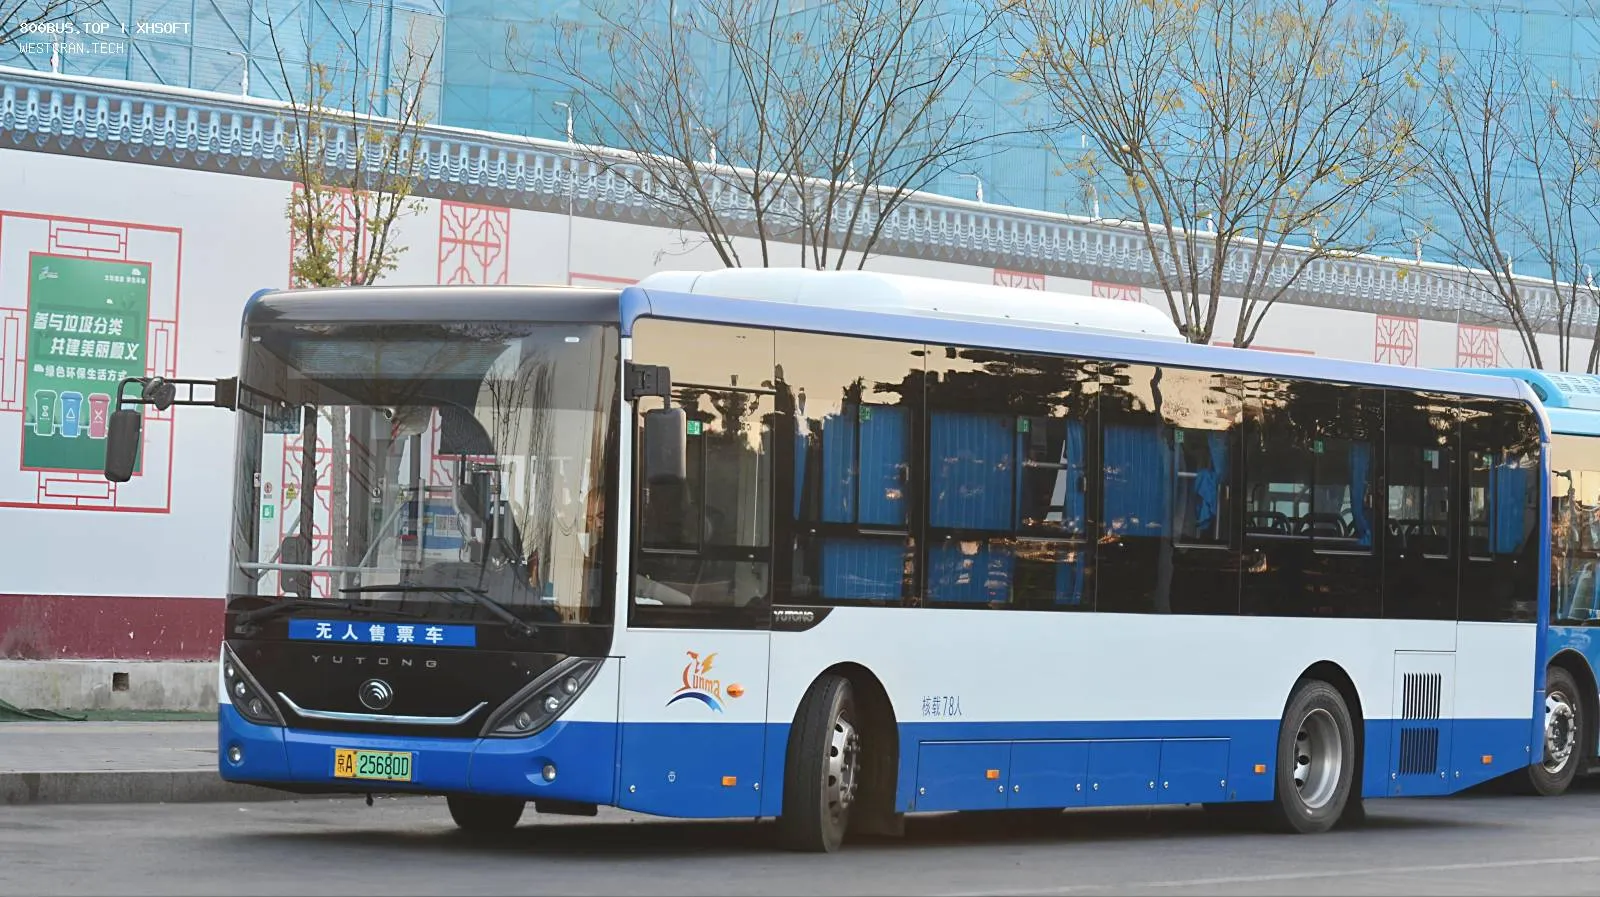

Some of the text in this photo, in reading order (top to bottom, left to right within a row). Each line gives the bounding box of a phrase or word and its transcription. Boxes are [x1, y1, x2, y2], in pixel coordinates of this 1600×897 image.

[33, 311, 124, 336] 参与垃圾分类
[50, 336, 140, 361] 共建美丽顺义
[44, 363, 128, 382] 绿色环保生活方式
[774, 609, 815, 623] YUTONG
[315, 621, 444, 644] 无人售票车
[311, 654, 438, 669] YUTONG
[921, 695, 963, 718] 核载78人
[337, 753, 410, 776] 京A 25680D
